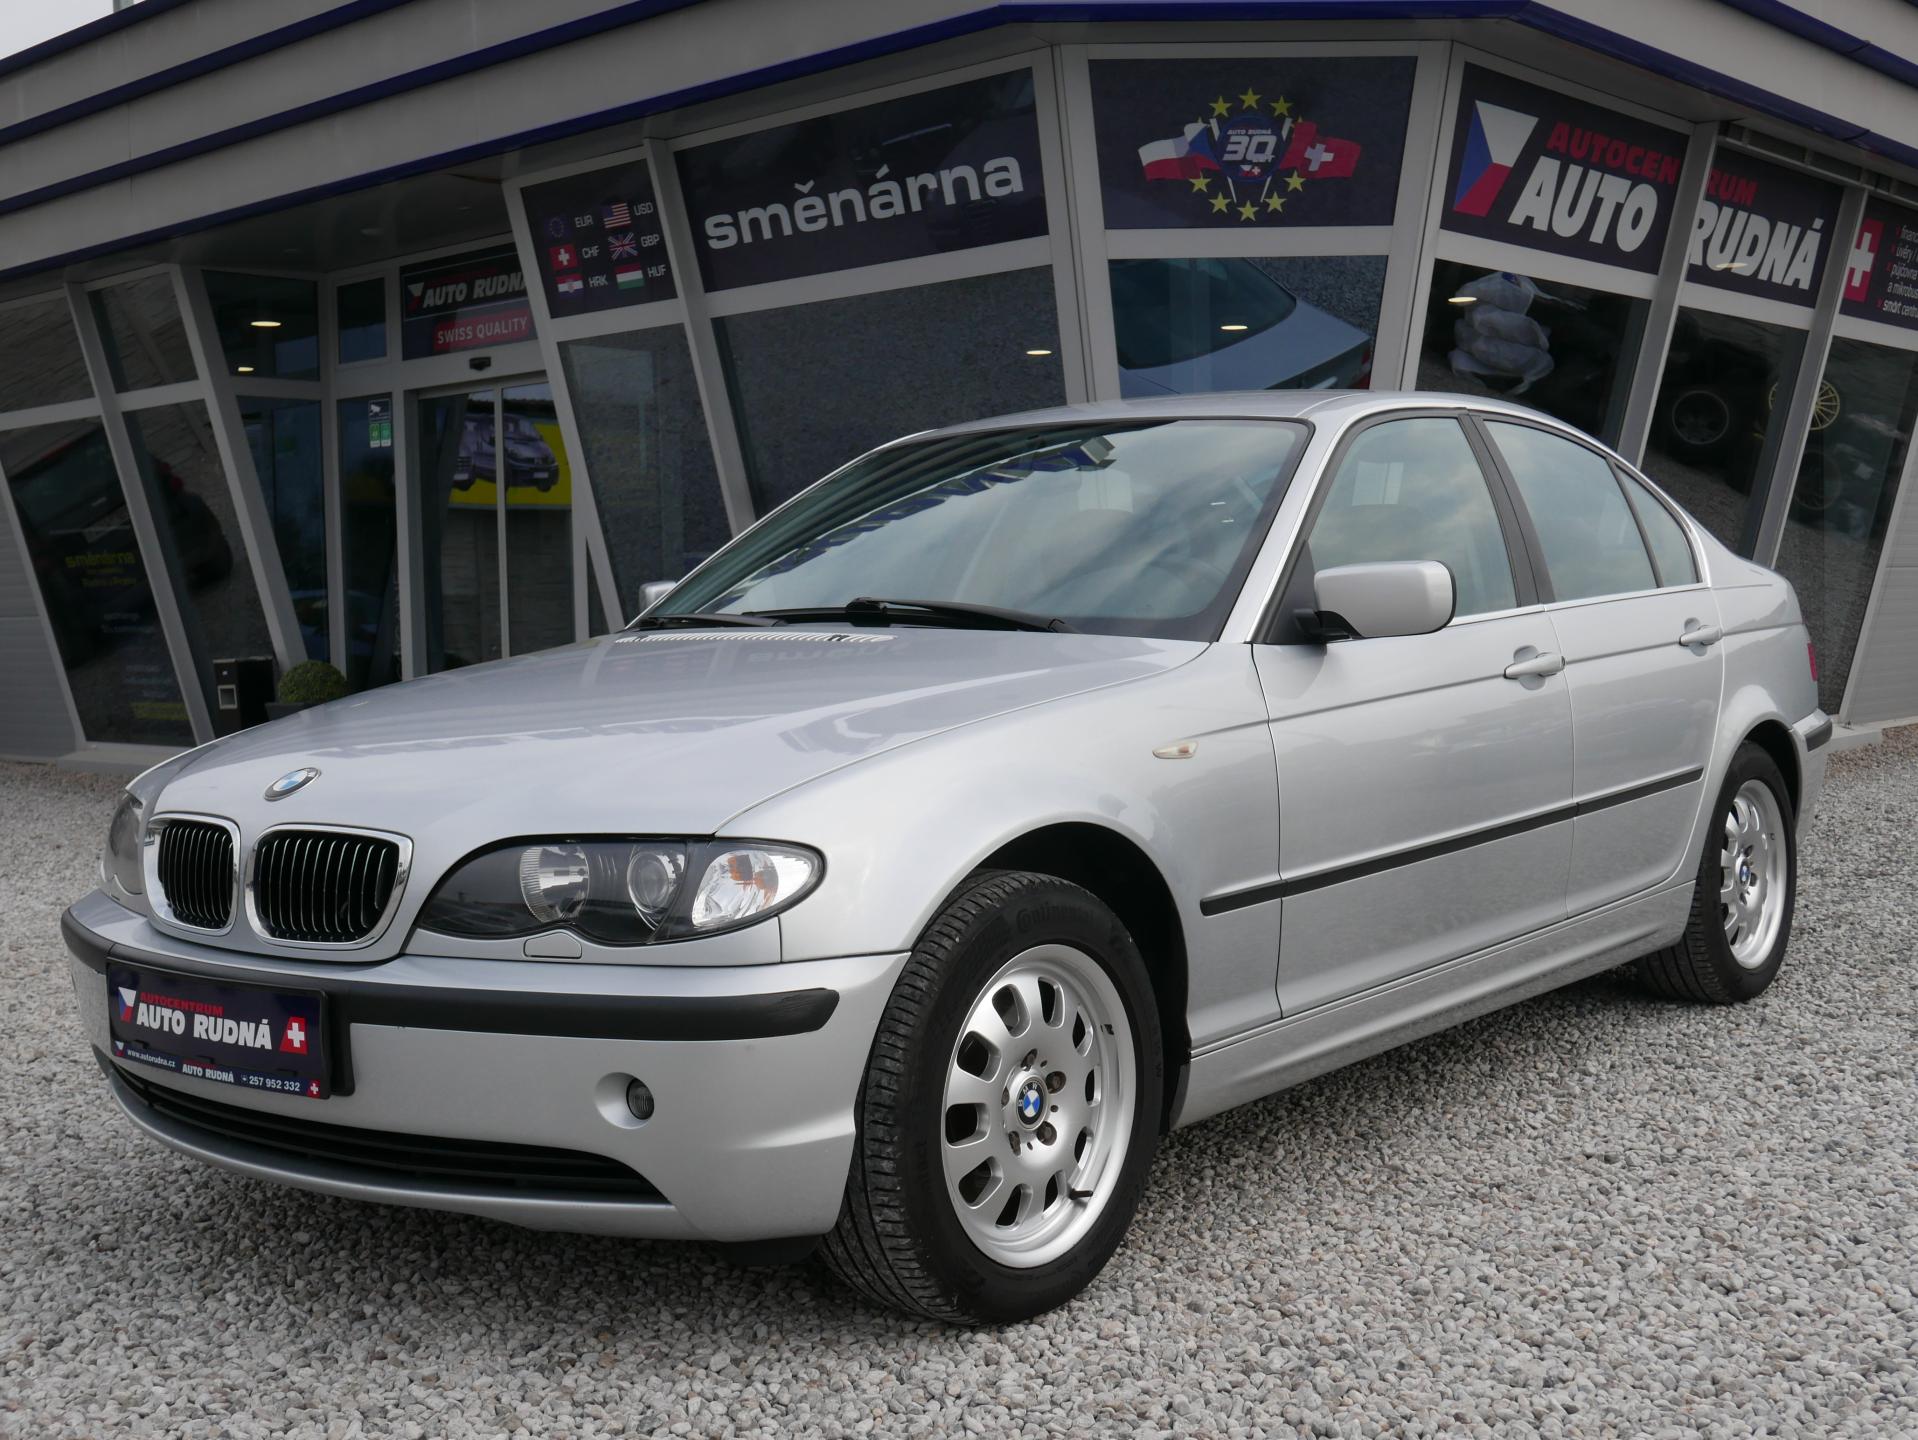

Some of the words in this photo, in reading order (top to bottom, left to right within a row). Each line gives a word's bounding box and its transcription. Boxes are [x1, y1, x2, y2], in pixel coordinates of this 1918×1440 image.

[1222, 135, 1277, 161] 30
[574, 215, 594, 228] EUR
[633, 202, 654, 216] USD
[704, 156, 1024, 250] směnárna
[1507, 155, 1658, 252] AUTO
[1688, 200, 1824, 290] RUDNÁ
[582, 245, 600, 259] CHF
[640, 234, 660, 247] GBP
[588, 274, 609, 288] HRK
[647, 264, 667, 278] HUF
[422, 282, 468, 308] AUTO
[473, 271, 527, 299] RUDN
[437, 324, 473, 344] SWISS
[476, 316, 528, 339] QUALITY
[140, 991, 224, 1016] AUTOCENTRUM
[136, 1003, 186, 1035] AUTO
[193, 1013, 272, 1050] RUDNÁ
[127, 1048, 176, 1069] www.autorudna.cz
[182, 1063, 203, 1077] AUTO
[205, 1069, 234, 1083] RUDNÁ
[249, 1075, 263, 1086] 257
[266, 1078, 282, 1089] 952
[283, 1080, 300, 1092] 332
